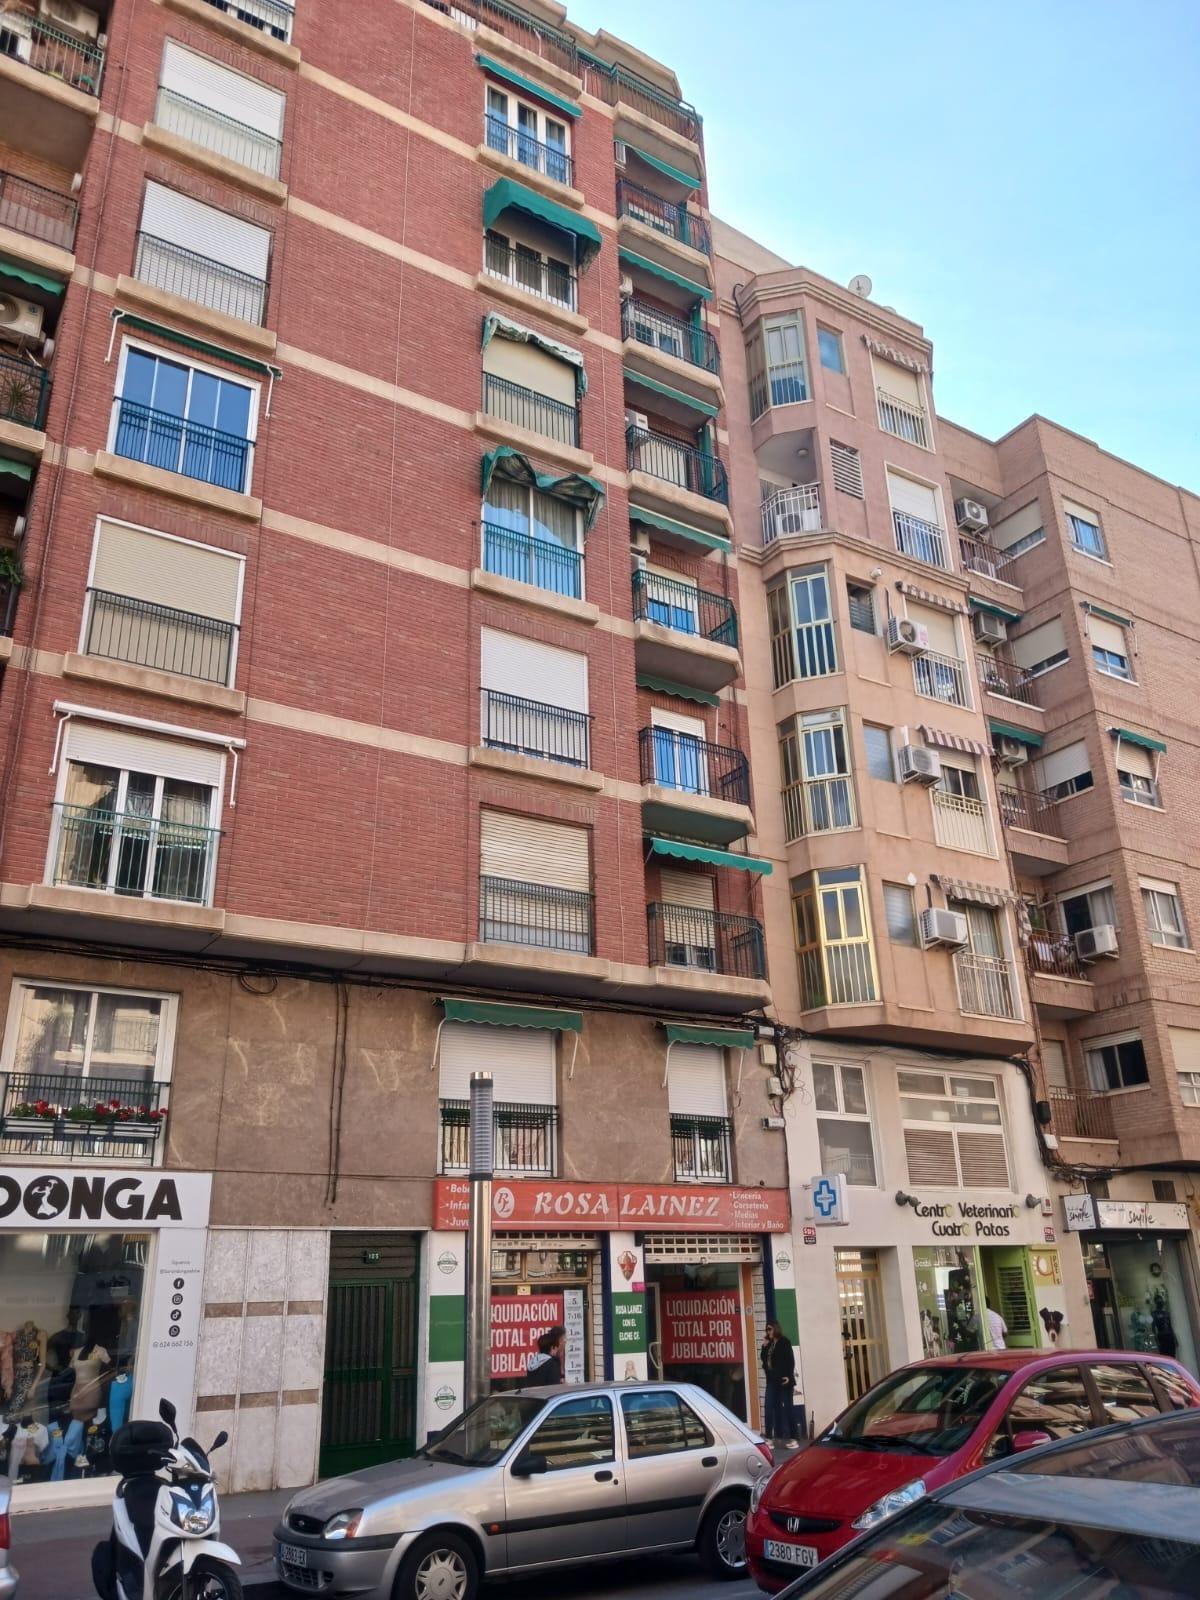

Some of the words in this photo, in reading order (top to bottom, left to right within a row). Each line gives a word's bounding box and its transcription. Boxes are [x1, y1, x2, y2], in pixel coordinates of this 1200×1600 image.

[450, 1183, 470, 1193] Beb
[534, 1191, 610, 1215] ROSA
[619, 1193, 720, 1217] LAINEZ
[958, 1202, 1020, 1219] Veterinario
[975, 1220, 1010, 1237] Patas
[491, 1300, 558, 1323] IQUIDACIÓN
[666, 1296, 736, 1317] LIQUIDACIÓN
[672, 1320, 707, 1338] TOTAL
[709, 1320, 732, 1337] POR
[671, 1339, 735, 1359] JUBILACIÓN
[769, 1542, 792, 1561] 2380
[795, 1547, 814, 1566] FGV
